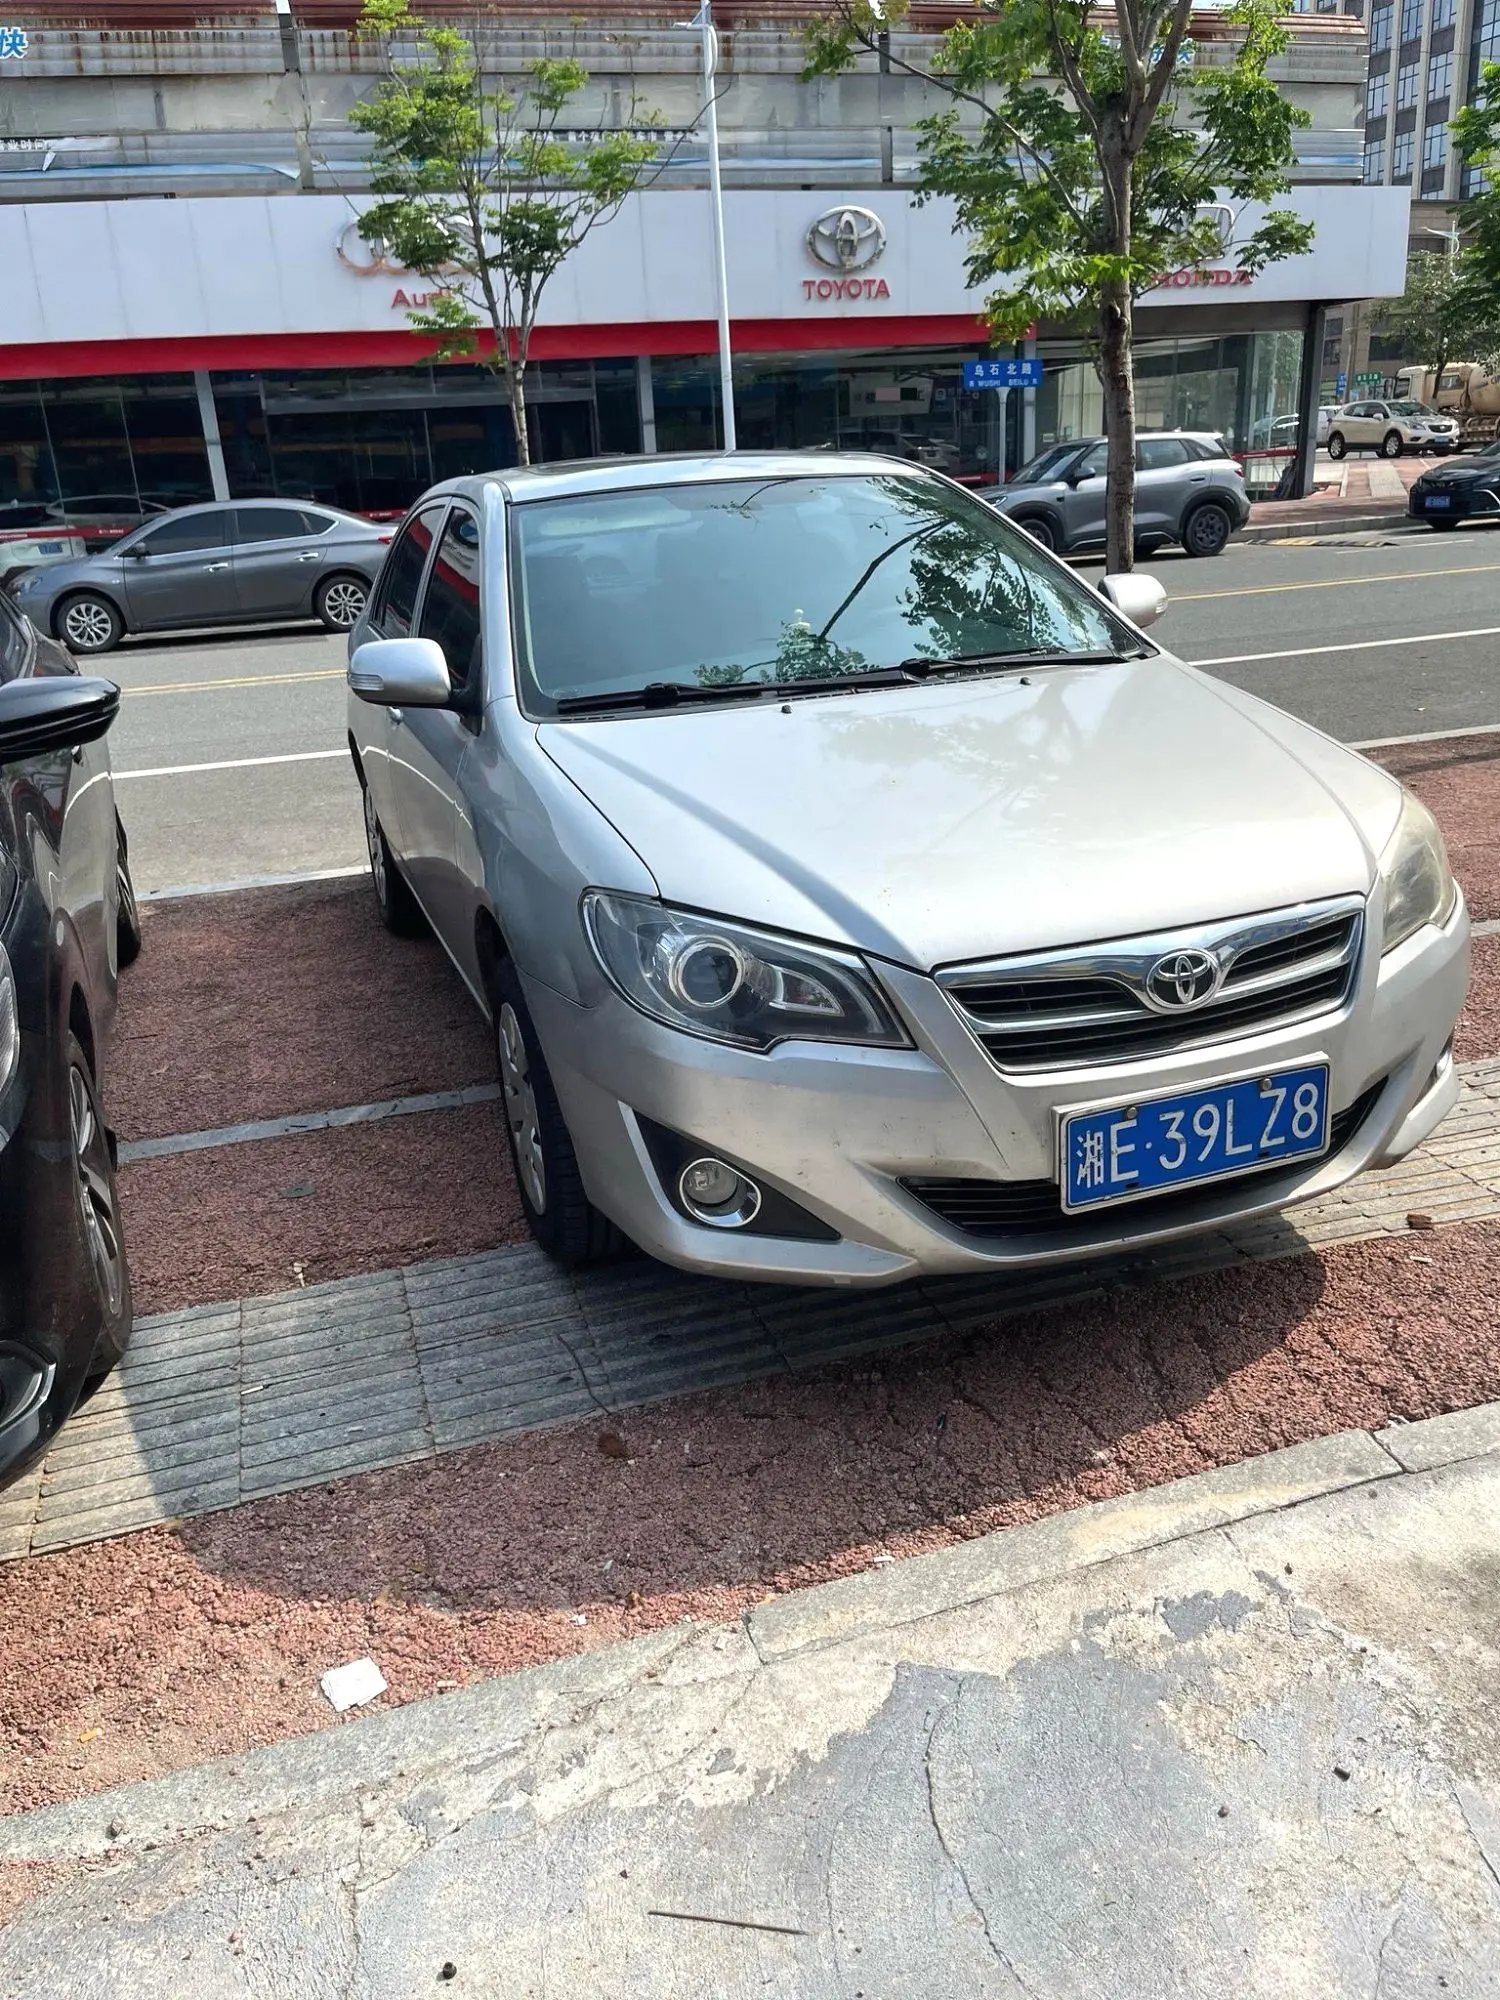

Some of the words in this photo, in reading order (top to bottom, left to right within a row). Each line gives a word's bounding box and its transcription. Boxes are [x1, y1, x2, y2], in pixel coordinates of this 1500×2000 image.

[391, 288, 453, 309] Au
[802, 278, 891, 300] TOYOTA
[974, 362, 1032, 377] 乌石北路
[1076, 1082, 1319, 1189] 湘E·39LZ8
